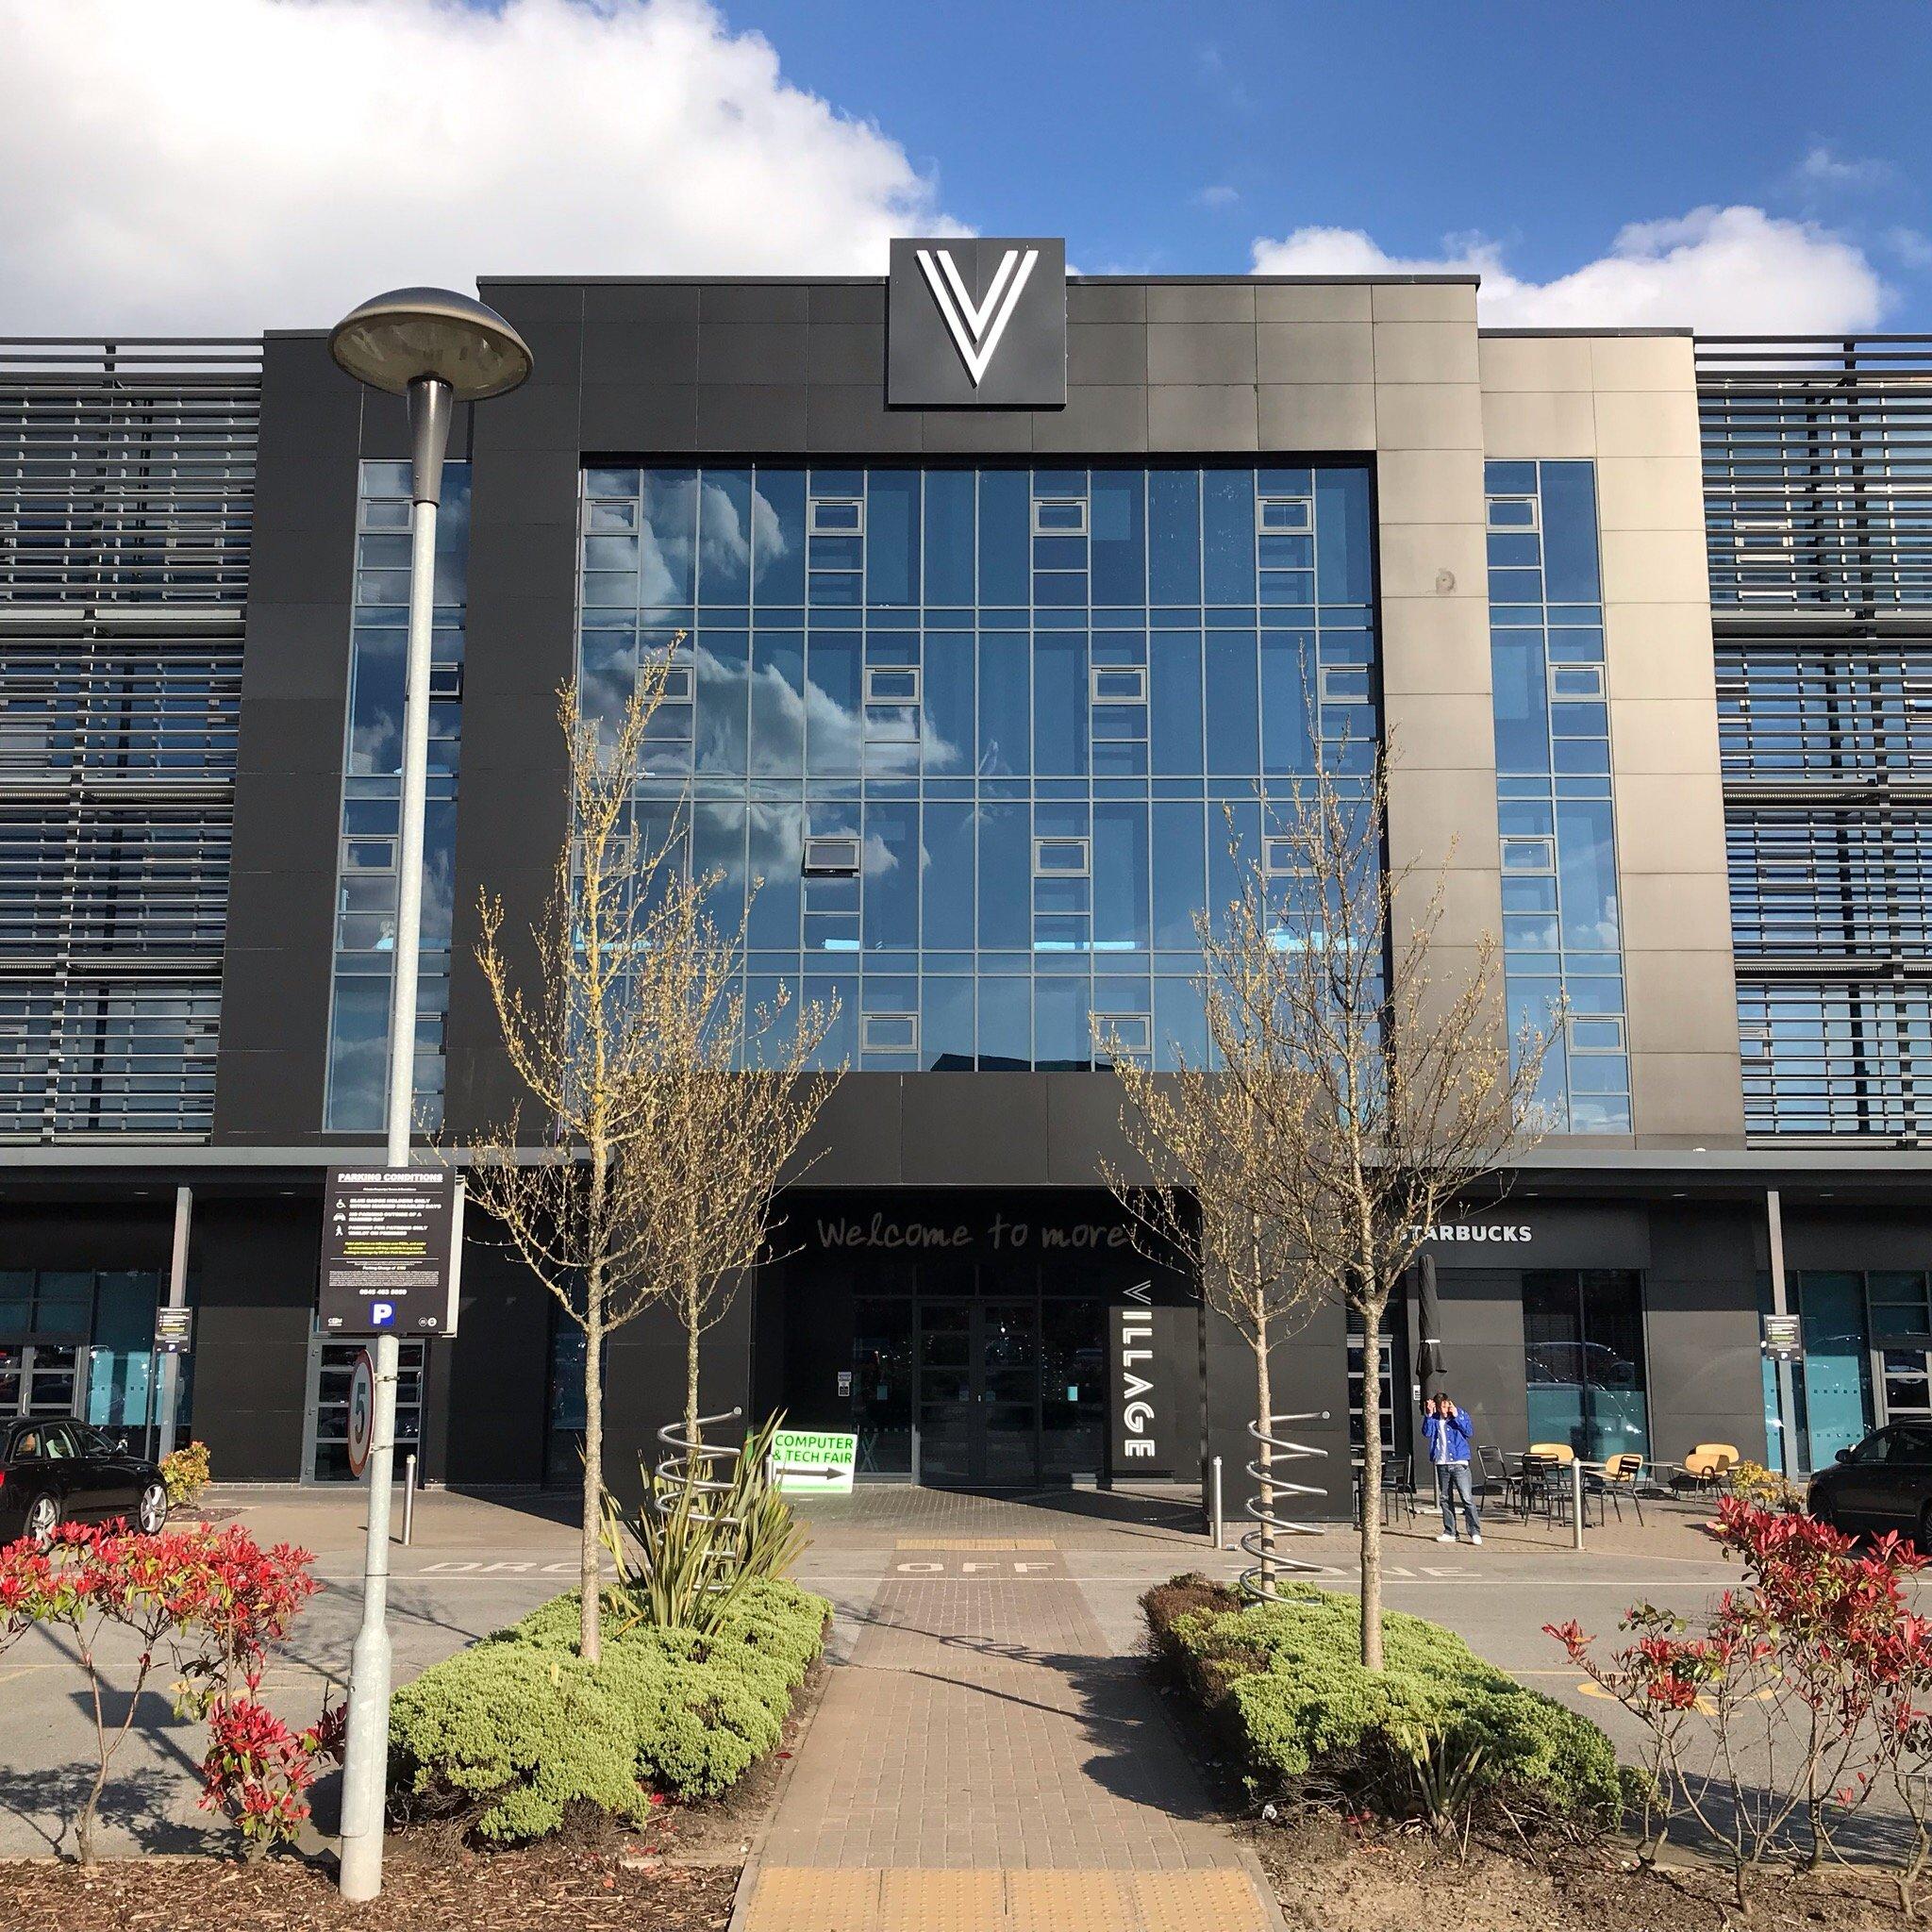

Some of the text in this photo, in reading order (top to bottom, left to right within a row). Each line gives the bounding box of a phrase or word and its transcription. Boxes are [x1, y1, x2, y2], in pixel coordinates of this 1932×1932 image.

[917, 250, 1039, 386] V
[338, 1173, 443, 1182] PARKING CONDITIONS
[817, 1212, 1128, 1249] Welcome to more
[1399, 1225, 1532, 1241] TARBUCKS
[373, 1304, 392, 1324] P
[1123, 1280, 1156, 1457] VILLAGE
[355, 1382, 366, 1444] 5
[774, 1434, 854, 1449] COMPUTER
[772, 1449, 853, 1463] & TECH FAIR
[896, 1562, 1055, 1573] OFF
